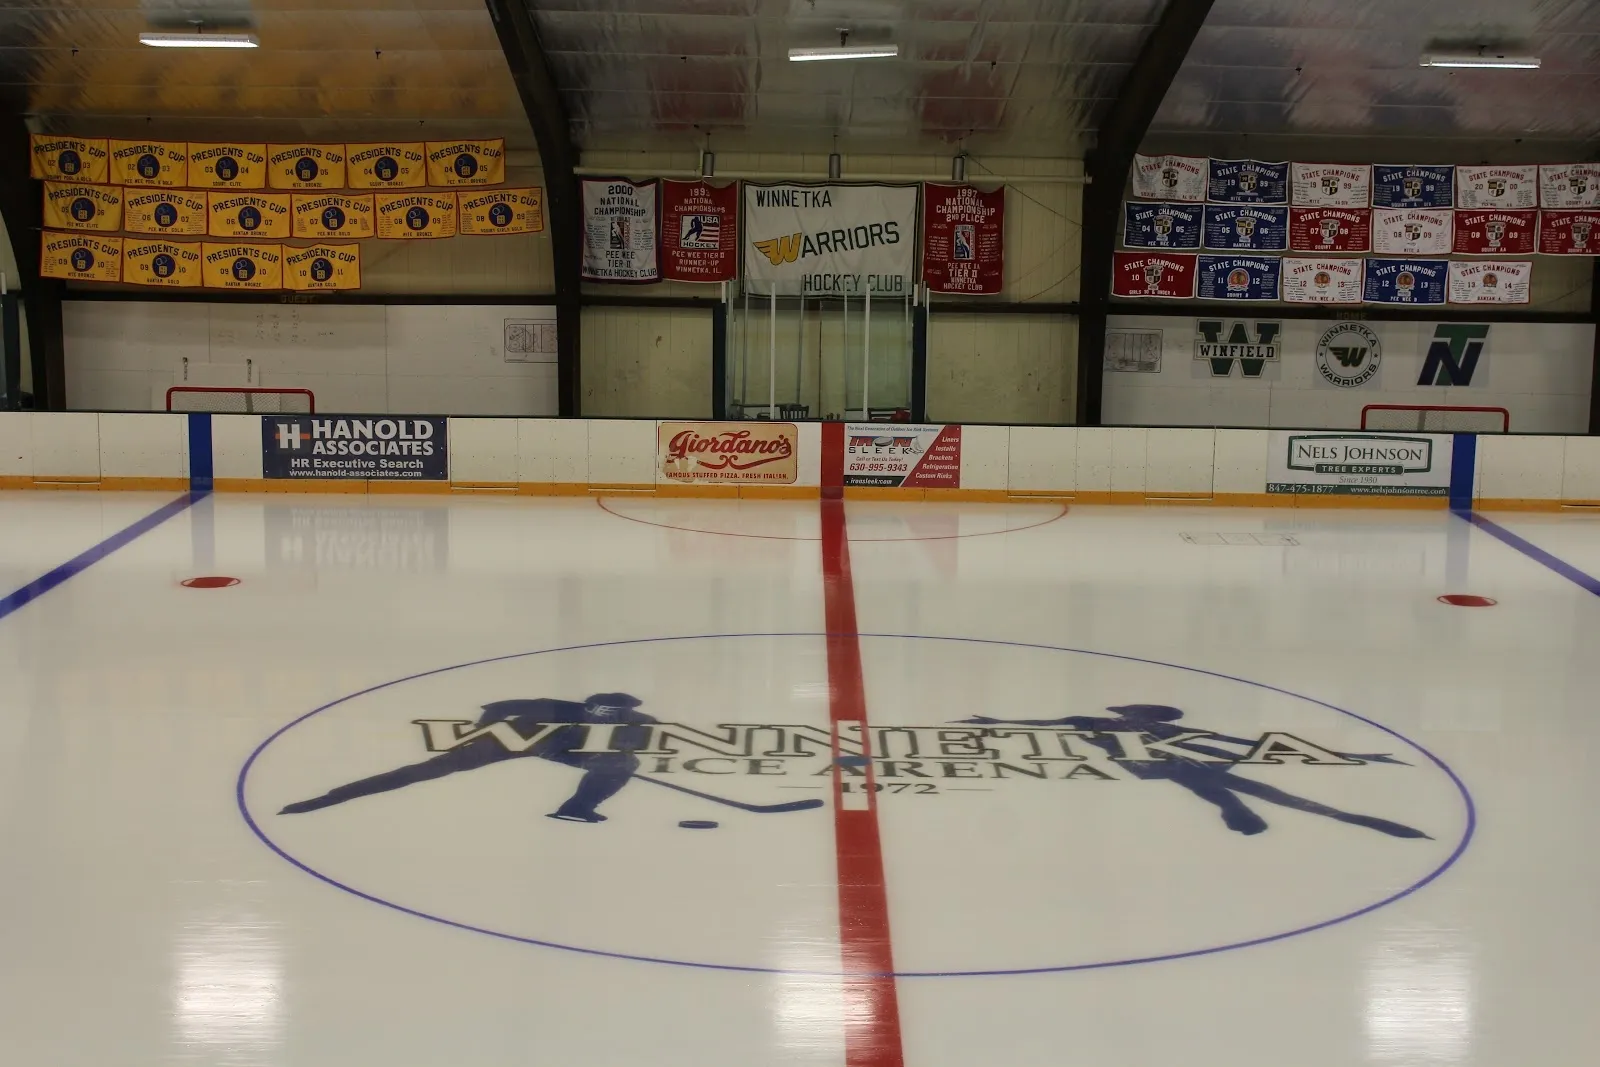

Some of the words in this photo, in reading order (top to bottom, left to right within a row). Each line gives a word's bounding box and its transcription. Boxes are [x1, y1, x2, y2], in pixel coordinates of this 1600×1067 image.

[88, 146, 106, 158] CUP
[168, 151, 185, 162] CUP
[247, 152, 264, 164] CUP
[325, 152, 343, 163] CUP
[405, 151, 422, 163] CUP
[483, 147, 502, 159] CUP
[1217, 166, 1238, 177] STATE
[1242, 164, 1280, 179] CHAMPIONS
[1301, 170, 1320, 180] STATE
[1323, 169, 1360, 181] CHAMPIONS
[1383, 171, 1403, 182] STATE
[1407, 170, 1446, 182] CHAMPIONS
[1468, 171, 1488, 181] STATE
[1490, 170, 1524, 181] CHAMPIONS
[1550, 171, 1568, 182] STATE
[608, 185, 633, 196] 2000
[957, 189, 978, 198] 1997
[102, 193, 119, 205] CUP
[186, 199, 203, 211] CUP
[520, 195, 538, 206] CUP
[600, 197, 639, 207] NATIONAL
[756, 190, 832, 208] WINNETKA
[946, 197, 984, 208] NATIONAL
[269, 203, 287, 214] CUP
[353, 202, 371, 213] CUP
[435, 200, 454, 211] CUP
[594, 207, 646, 216] CHAMPIONSHIP
[936, 204, 995, 216] CHAMPIONSHIP
[960, 214, 985, 223] PLACE
[1135, 210, 1154, 221] STATE
[1158, 208, 1192, 222] CHAMPIONS
[1215, 211, 1236, 222] STATE
[1240, 209, 1277, 223] CHAMPIONS
[1300, 211, 1320, 222] STATE
[1323, 210, 1360, 223] CHAMPIONS
[1384, 214, 1403, 225] STATE
[1408, 213, 1443, 226] CHAMPIONS
[1465, 215, 1486, 226] STATE
[1489, 213, 1526, 227] CHAMPIONS
[1551, 217, 1571, 228] STATE
[753, 221, 900, 266] WARRIORS
[101, 244, 119, 256] CUP
[181, 250, 199, 262] CUP
[606, 251, 620, 259] PEE
[622, 251, 635, 259] WEE
[262, 251, 279, 263] CUP
[338, 252, 356, 263] CUP
[1124, 260, 1145, 271] STATE
[1148, 258, 1185, 273] CHAMPIONS
[1208, 261, 1230, 272] STATE
[1232, 259, 1270, 273] CHAMPIONS
[1293, 264, 1313, 275] STATE
[1316, 263, 1352, 276] CHAMPIONS
[1376, 265, 1397, 277] STATE
[1400, 264, 1437, 278] CHAMPIONS
[1460, 266, 1480, 277] STATE
[1482, 265, 1520, 276] CHAMPIONS
[582, 266, 612, 276] WINNETKA
[614, 269, 637, 278] HOCKEY
[639, 268, 657, 277] CLUB
[949, 269, 969, 277] TIER
[803, 274, 861, 292] HOCKEY
[867, 274, 903, 292] CLUB
[1320, 323, 1377, 348] WINNETKA
[1199, 344, 1275, 358] WINFIELD
[1320, 362, 1377, 387] WARRIORS
[311, 419, 434, 440] HANOLD
[277, 423, 301, 449] H
[312, 440, 434, 456] ASSOCIATES
[668, 430, 792, 459] Giordano's
[849, 446, 909, 455] SLEEK
[1298, 444, 1338, 459] NELS
[1342, 446, 1423, 463] JOHNSON
[291, 458, 310, 468] HR
[313, 459, 376, 468] Executive
[379, 459, 424, 469] Search
[849, 463, 908, 471] 630-995-9343
[289, 469, 422, 477] www.hanold-associates.com
[850, 477, 892, 485] ironsleek.com
[1268, 484, 1334, 493] 847-475-1877
[1350, 487, 1446, 495] www.nelsjohnsontree.com
[411, 719, 1367, 766] WINNETKA
[650, 757, 788, 776] ICE
[822, 758, 1121, 781] ARENA
[841, 783, 939, 795] 1972
